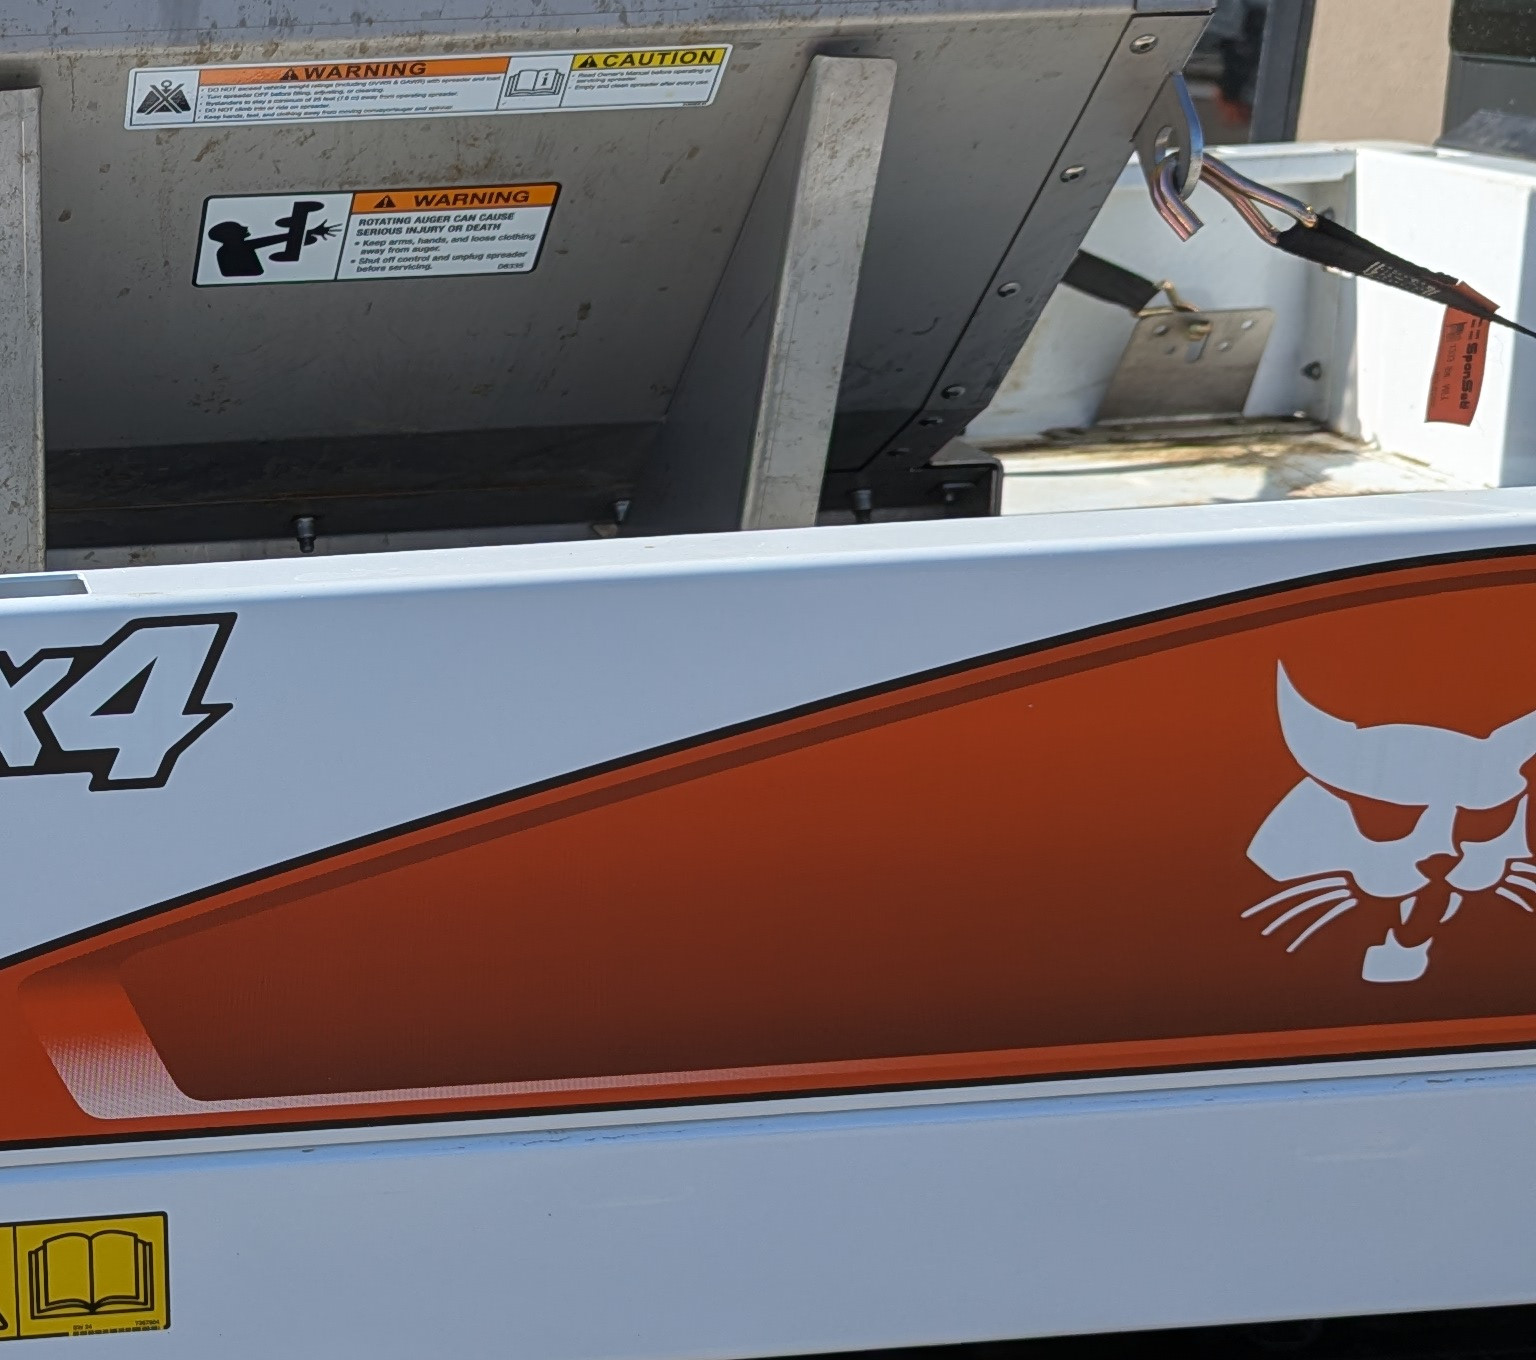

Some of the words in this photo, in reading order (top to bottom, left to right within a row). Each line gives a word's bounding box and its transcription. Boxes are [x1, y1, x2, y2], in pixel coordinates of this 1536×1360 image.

[602, 51, 715, 67] CAUTION
[304, 62, 427, 80] WARNING
[414, 190, 530, 207] WARNING
[358, 216, 412, 226] ROTATING
[414, 214, 450, 224] AUGER
[453, 213, 476, 222] CAN
[478, 212, 515, 222] CAUSE
[356, 226, 403, 236] SERIOUS
[405, 225, 445, 235] INJURY
[448, 224, 462, 232] OR
[465, 223, 501, 232] DEATH
[363, 239, 387, 248] Keep
[450, 235, 468, 243] and
[471, 234, 495, 242] loose
[498, 232, 536, 242] clothing
[397, 254, 430, 263] control
[432, 253, 449, 262] and
[452, 252, 484, 262] unplug
[485, 251, 527, 260] spreader
[356, 265, 386, 273] before
